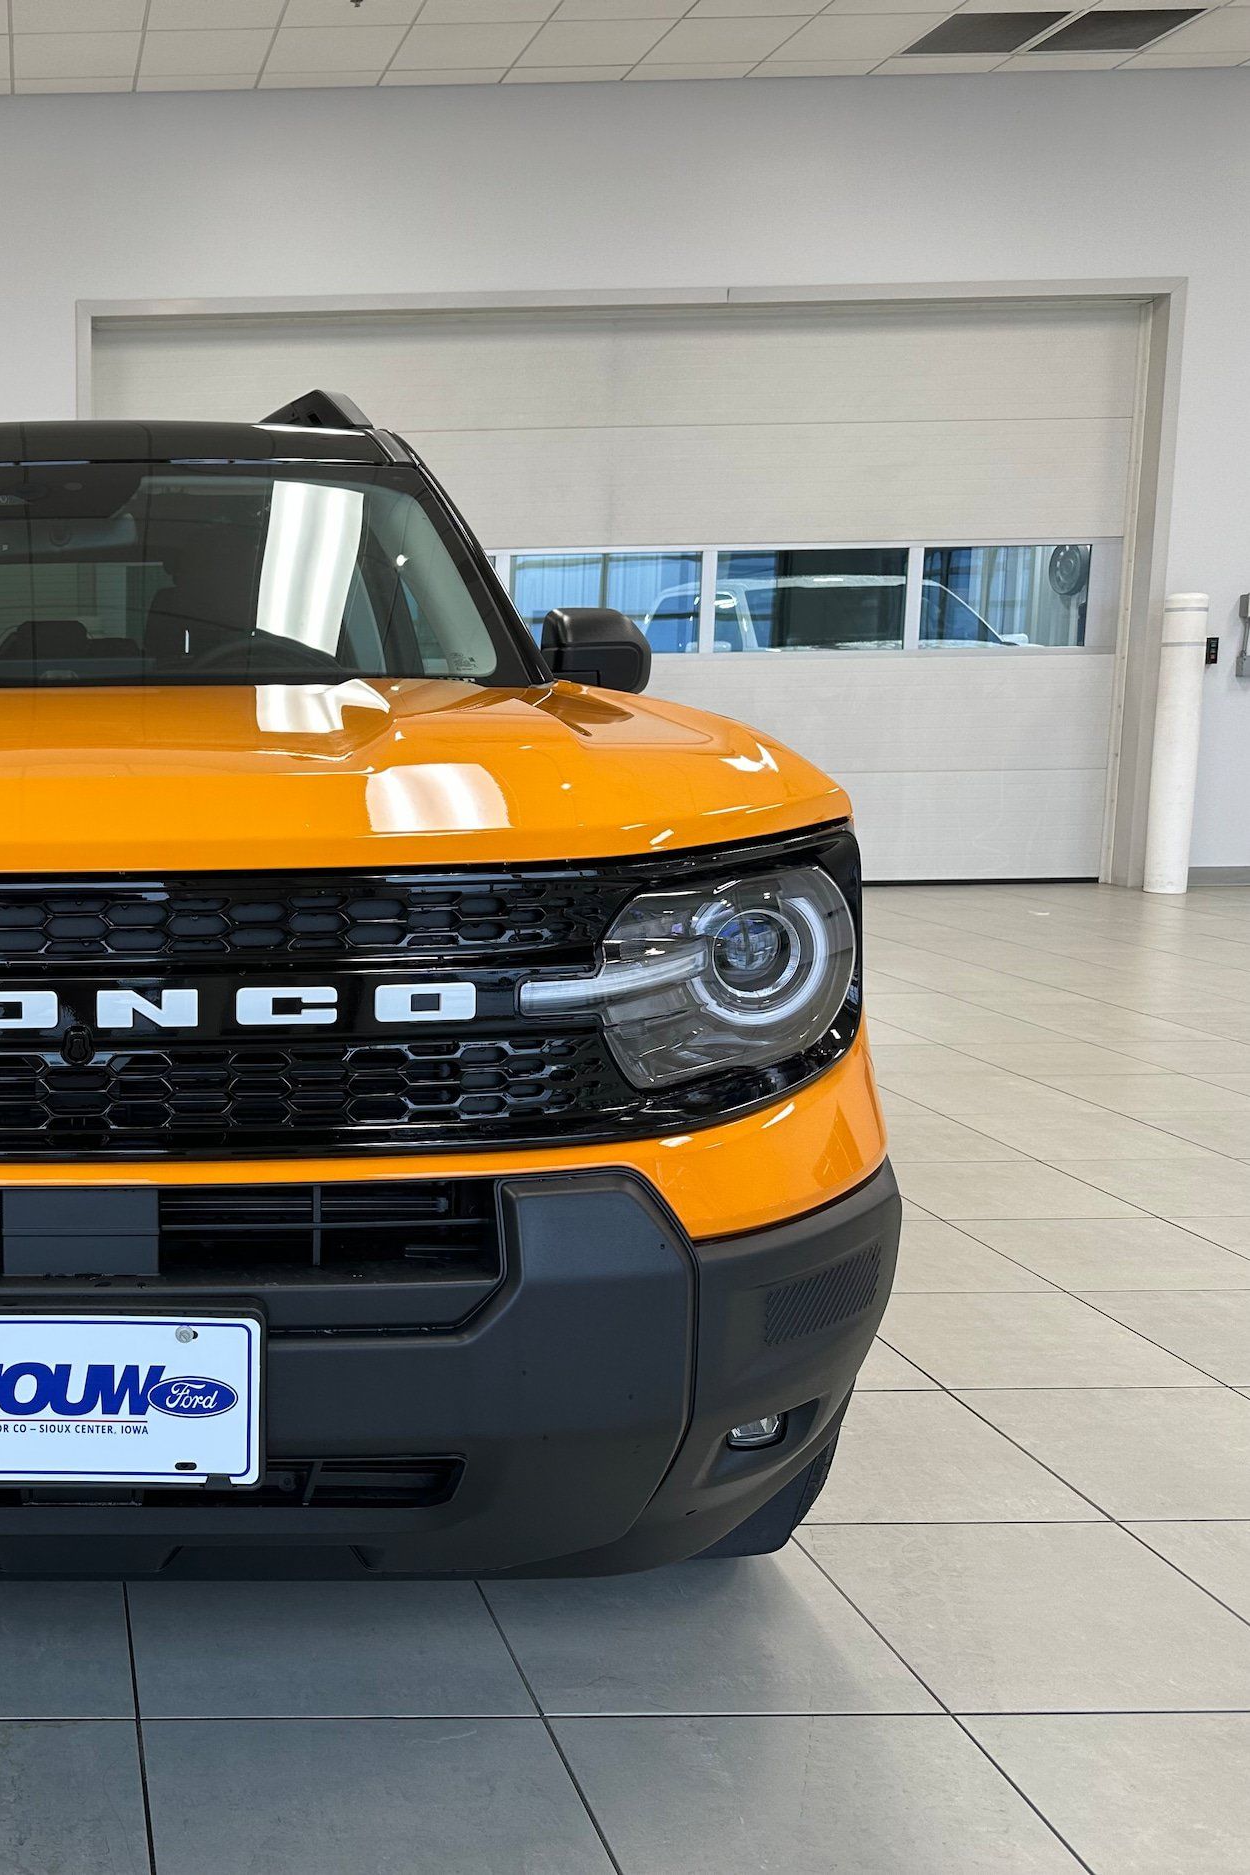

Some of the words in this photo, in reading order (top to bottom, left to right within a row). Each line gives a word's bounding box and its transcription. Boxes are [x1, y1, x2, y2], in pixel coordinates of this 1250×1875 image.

[165, 1382, 218, 1410] Ford
[13, 1424, 27, 1434] CO
[39, 1424, 71, 1434] SIOUX
[121, 1424, 149, 1435] IOWA
